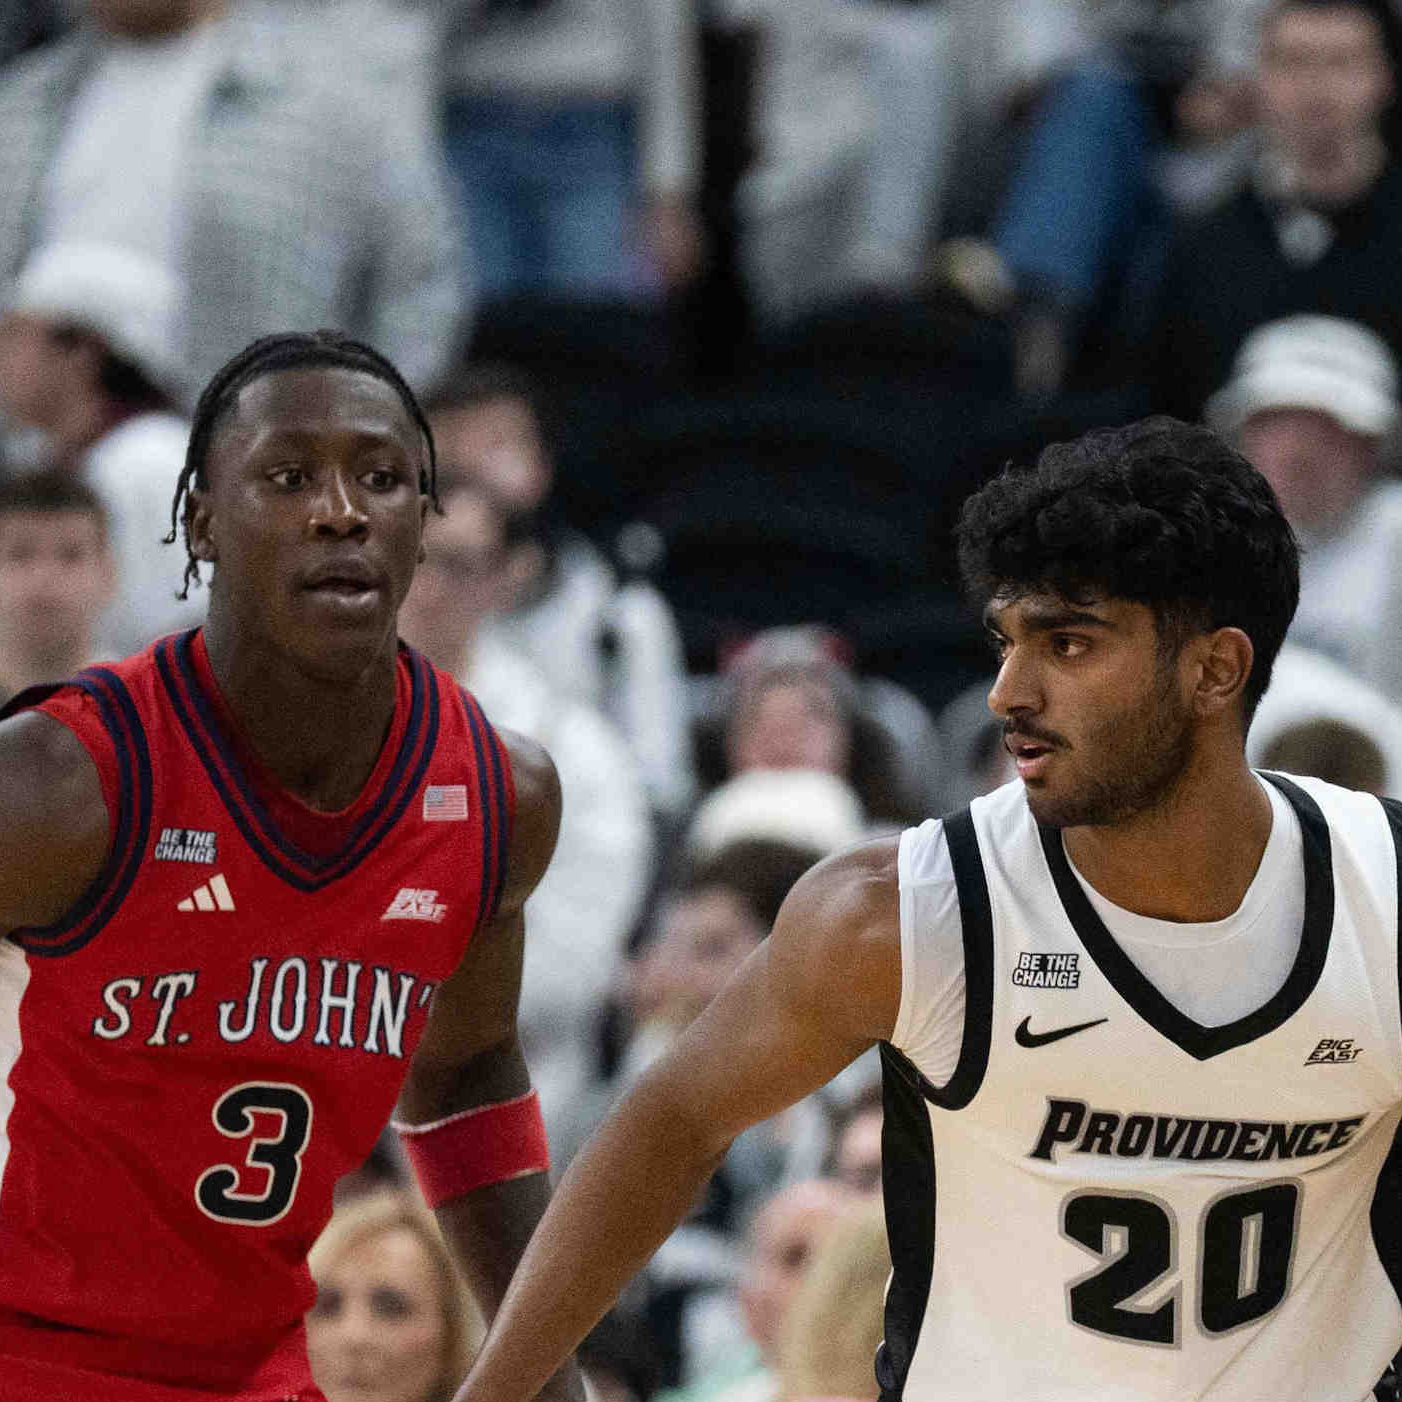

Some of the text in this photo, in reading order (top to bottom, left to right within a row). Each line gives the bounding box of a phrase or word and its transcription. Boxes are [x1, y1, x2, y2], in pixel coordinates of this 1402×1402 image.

[160, 827, 217, 848] BE THE
[154, 843, 217, 865] CHANGE
[1018, 952, 1079, 972] BE THE
[1012, 968, 1080, 988] CHANGE
[92, 971, 201, 1047] ST.
[1306, 1048, 1365, 1062] EAST
[1315, 1038, 1355, 1051] BIG
[1024, 1096, 1370, 1163] PROVIDENCE
[194, 1081, 314, 1227] 3
[1057, 1177, 1305, 1351] 20
